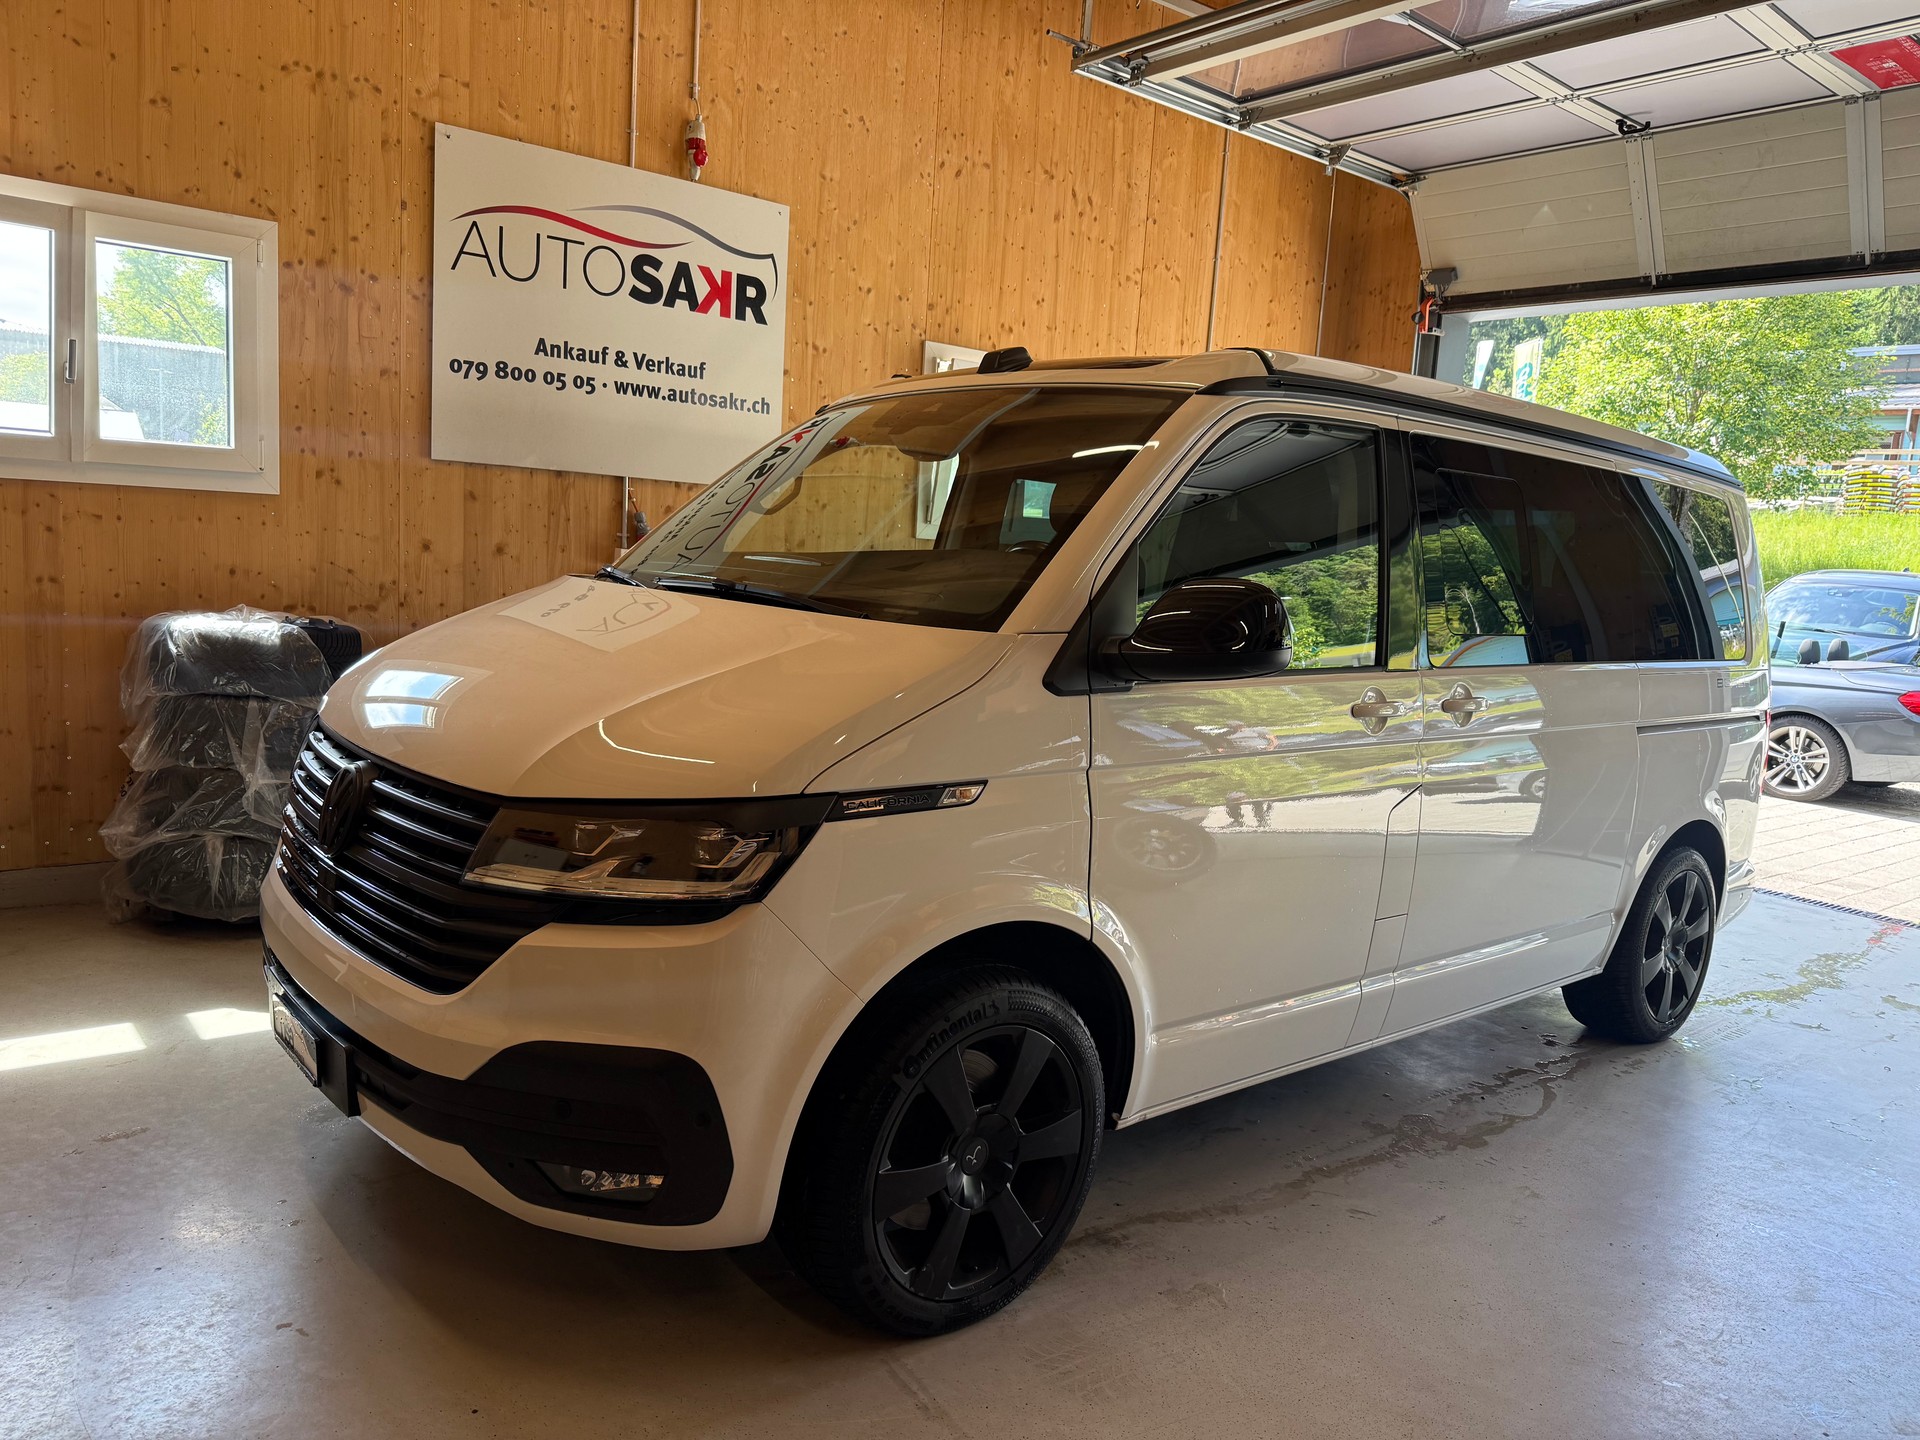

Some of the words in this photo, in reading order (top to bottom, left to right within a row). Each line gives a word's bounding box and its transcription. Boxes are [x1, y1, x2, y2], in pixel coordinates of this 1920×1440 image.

[534, 337, 609, 366] Ankauf
[613, 350, 630, 369] &
[632, 351, 707, 380] Verkauf
[449, 358, 489, 381] 079
[494, 360, 537, 383] 800
[542, 371, 567, 391] 05
[572, 374, 597, 395] 05
[613, 380, 772, 415] www.autosakr.ch
[847, 794, 931, 810] CALIFORNIA
